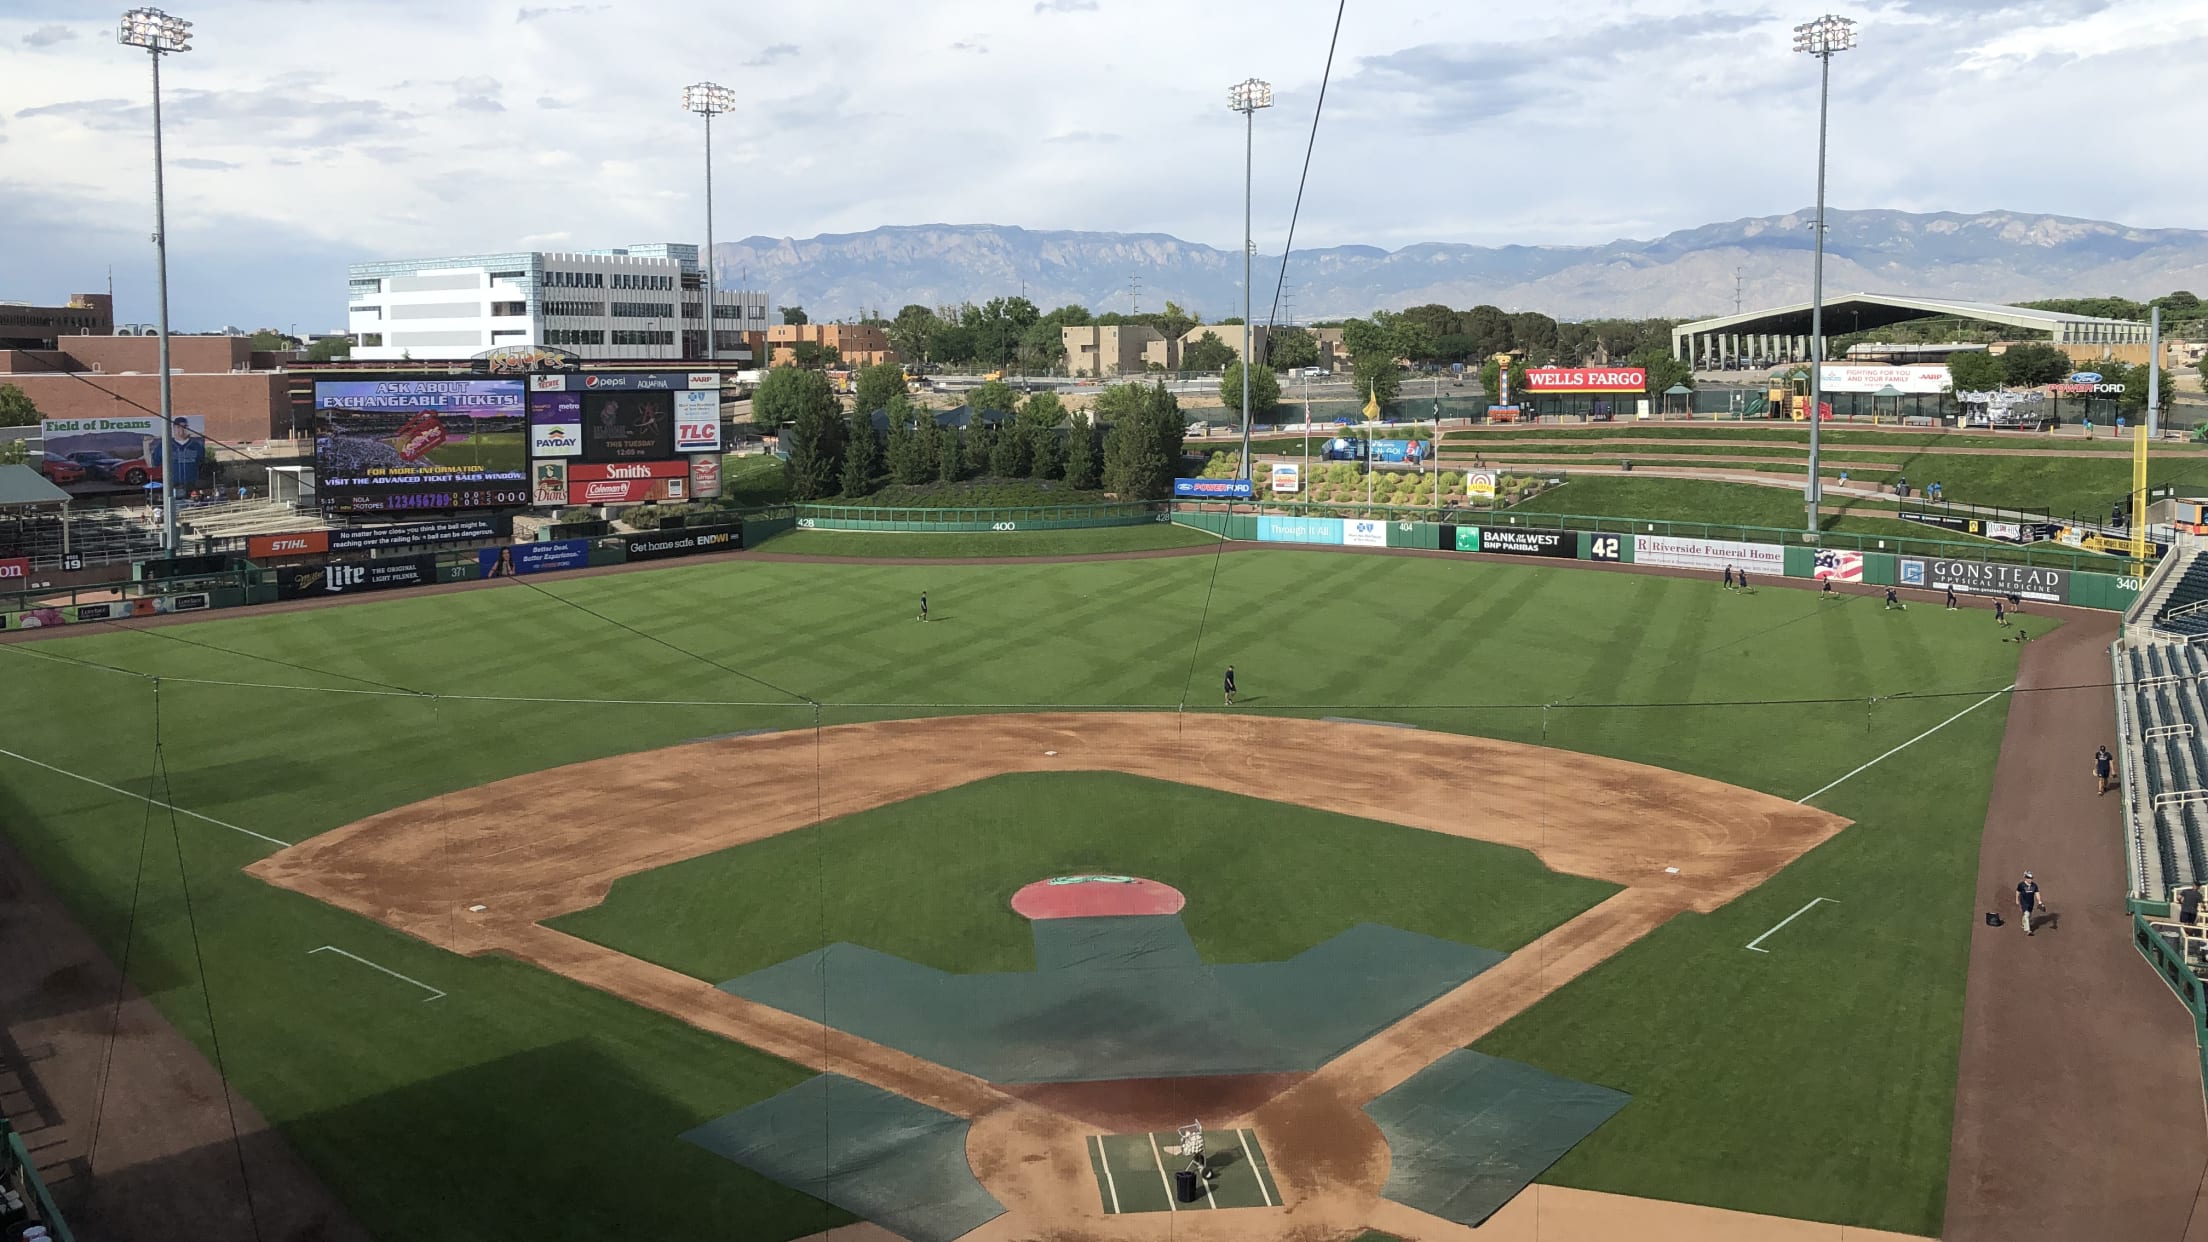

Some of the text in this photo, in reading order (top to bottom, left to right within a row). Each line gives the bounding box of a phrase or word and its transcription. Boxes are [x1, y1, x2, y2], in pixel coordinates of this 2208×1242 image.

[600, 376, 626, 387] pepsi
[1528, 372, 1643, 385] WELLS FARGO
[376, 382, 469, 394] ASK ABOUT
[323, 395, 519, 408] EXCHANGEABLE TICKETS!
[46, 419, 152, 432] Field of Dreams
[679, 423, 716, 439] TLC
[536, 438, 576, 448] PAYDAY
[367, 465, 484, 476] FOR MORE INFORMATION
[606, 463, 652, 479] Smith's
[325, 478, 349, 486] VISIT
[352, 477, 369, 485] THE
[372, 475, 420, 485] ADVANCED
[422, 474, 452, 483] TICKET
[455, 473, 482, 482] SALES
[589, 483, 621, 494] Coleman
[534, 489, 567, 501] Dion's
[797, 518, 815, 528] 428
[1156, 513, 1170, 522] 428
[351, 530, 373, 538] matter
[460, 522, 478, 530] might
[992, 521, 1016, 531] 400
[1271, 524, 1306, 536] Through
[1309, 526, 1315, 535] It
[1399, 522, 1413, 532] 404
[333, 539, 362, 548] reaching
[390, 535, 411, 543] railing
[427, 532, 439, 540] ball
[697, 533, 729, 546] ENDWI
[1483, 531, 1516, 543] BANK
[1527, 533, 1560, 546] WEST
[271, 539, 308, 551] STIHL
[630, 543, 647, 553] Get
[648, 541, 674, 551] home
[1483, 541, 1539, 552] BNP PARIBAS
[1592, 537, 1619, 558] 42
[1637, 538, 1781, 561] R Riverside Funeral Home
[64, 559, 81, 570] 19
[387, 564, 417, 573] ORIGINAL
[451, 566, 467, 577] 371
[1933, 561, 2059, 586] GONSTEAD
[324, 565, 365, 591] Lite
[372, 575, 391, 583] LIGHT
[1940, 575, 2051, 593] PHYSICAL MEDICINE
[2116, 577, 2138, 591] 340
